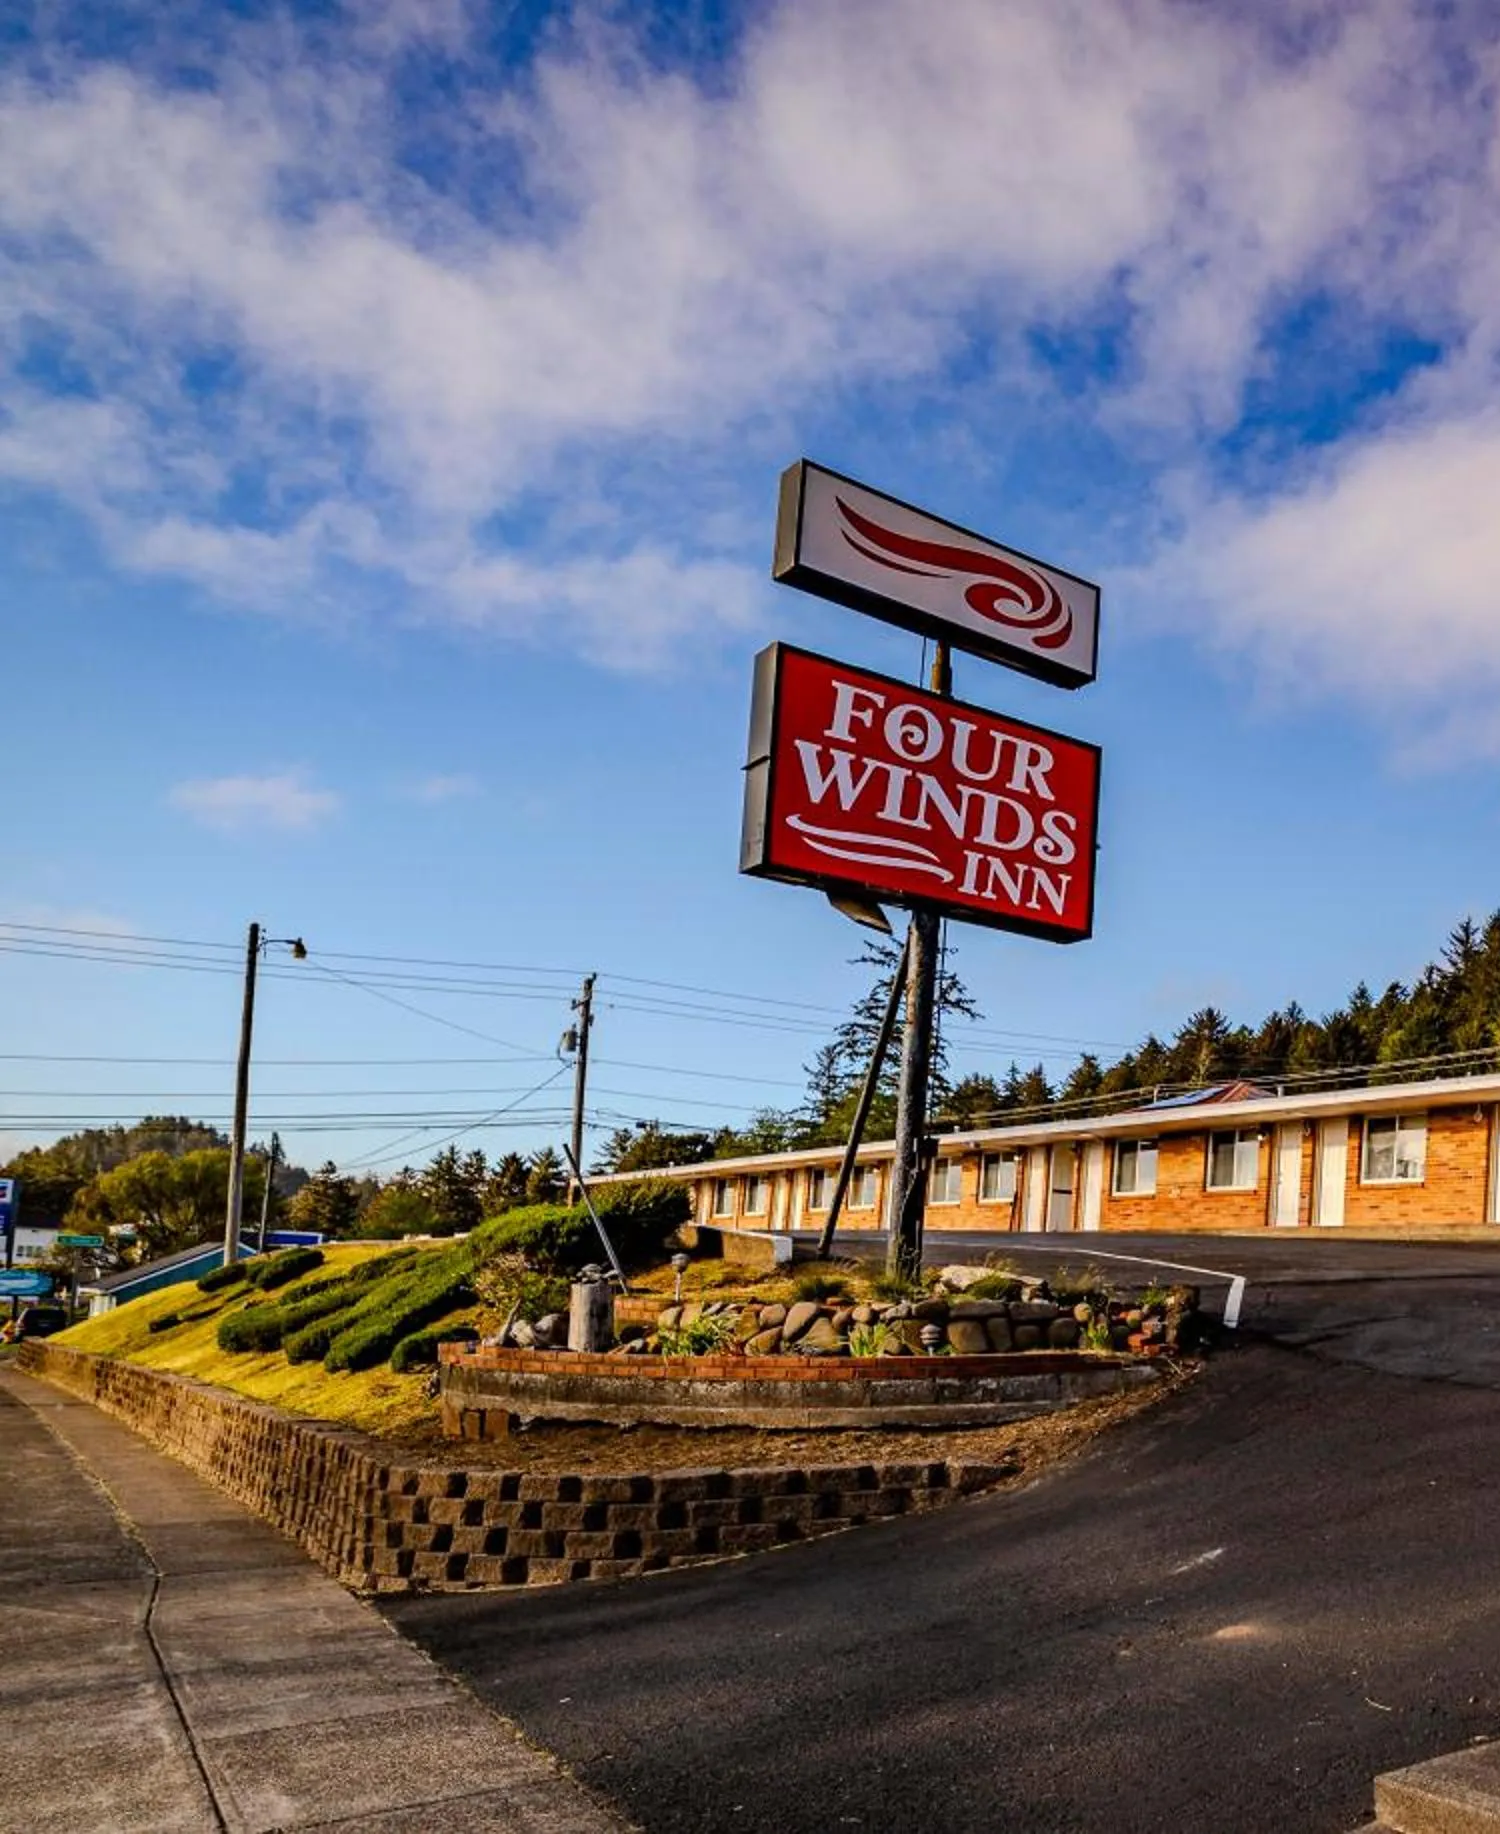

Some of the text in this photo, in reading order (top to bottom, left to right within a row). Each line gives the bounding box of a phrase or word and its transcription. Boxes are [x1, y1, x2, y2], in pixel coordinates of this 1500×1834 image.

[824, 679, 1055, 800] FOUR
[794, 739, 1077, 865] WINDS
[958, 850, 1071, 916] INN
